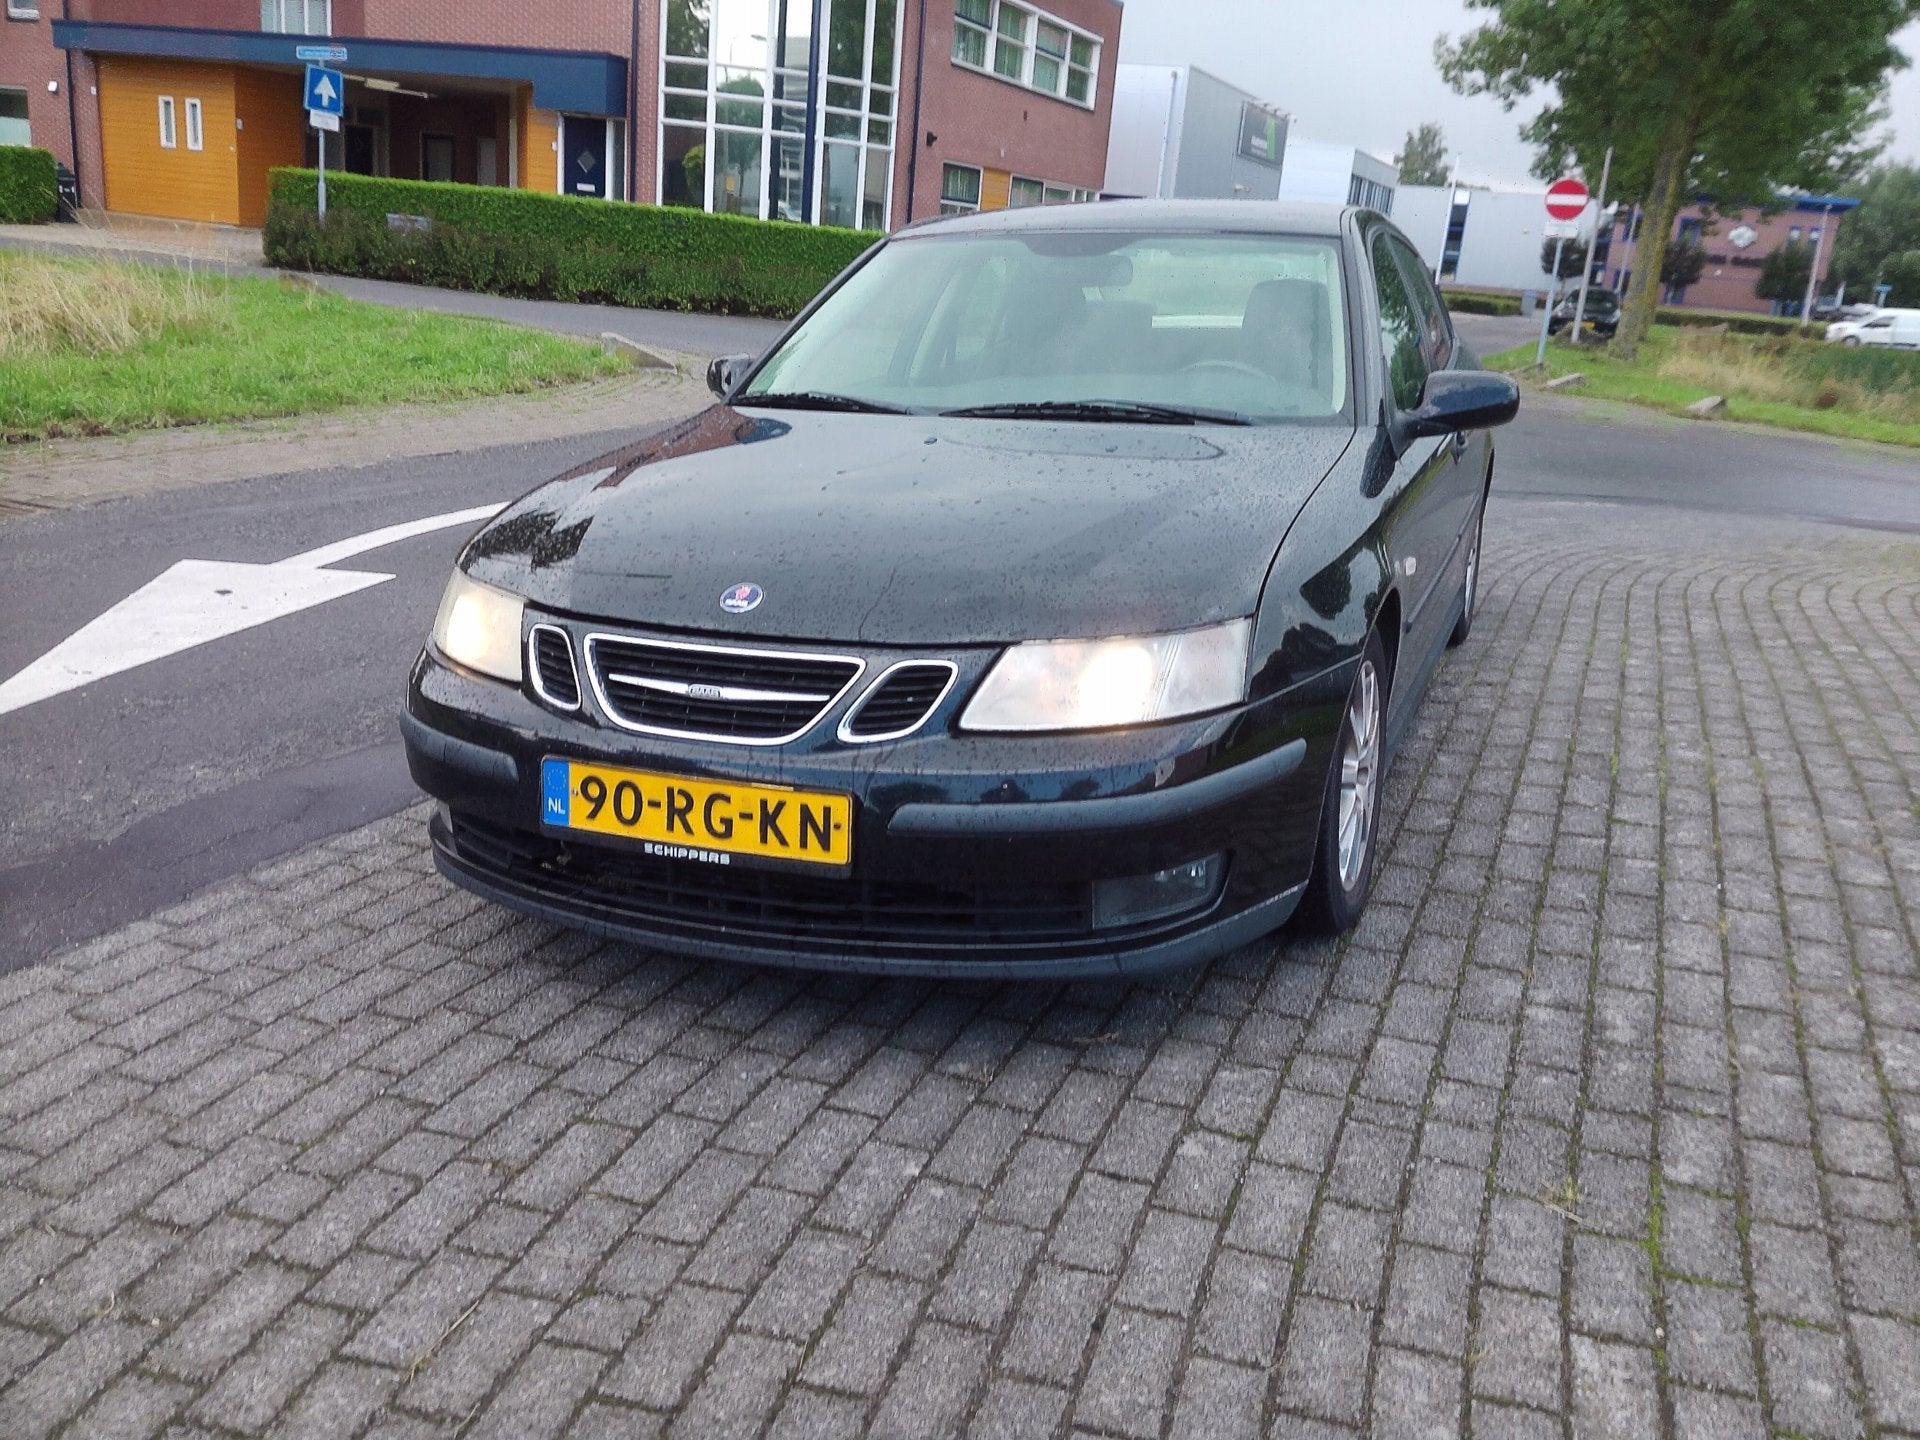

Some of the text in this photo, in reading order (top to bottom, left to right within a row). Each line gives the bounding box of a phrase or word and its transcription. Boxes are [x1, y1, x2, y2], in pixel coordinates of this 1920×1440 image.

[548, 796, 566, 815] NL
[579, 775, 831, 852] 90-RG-KN
[644, 842, 730, 865] SCHIPPERS
